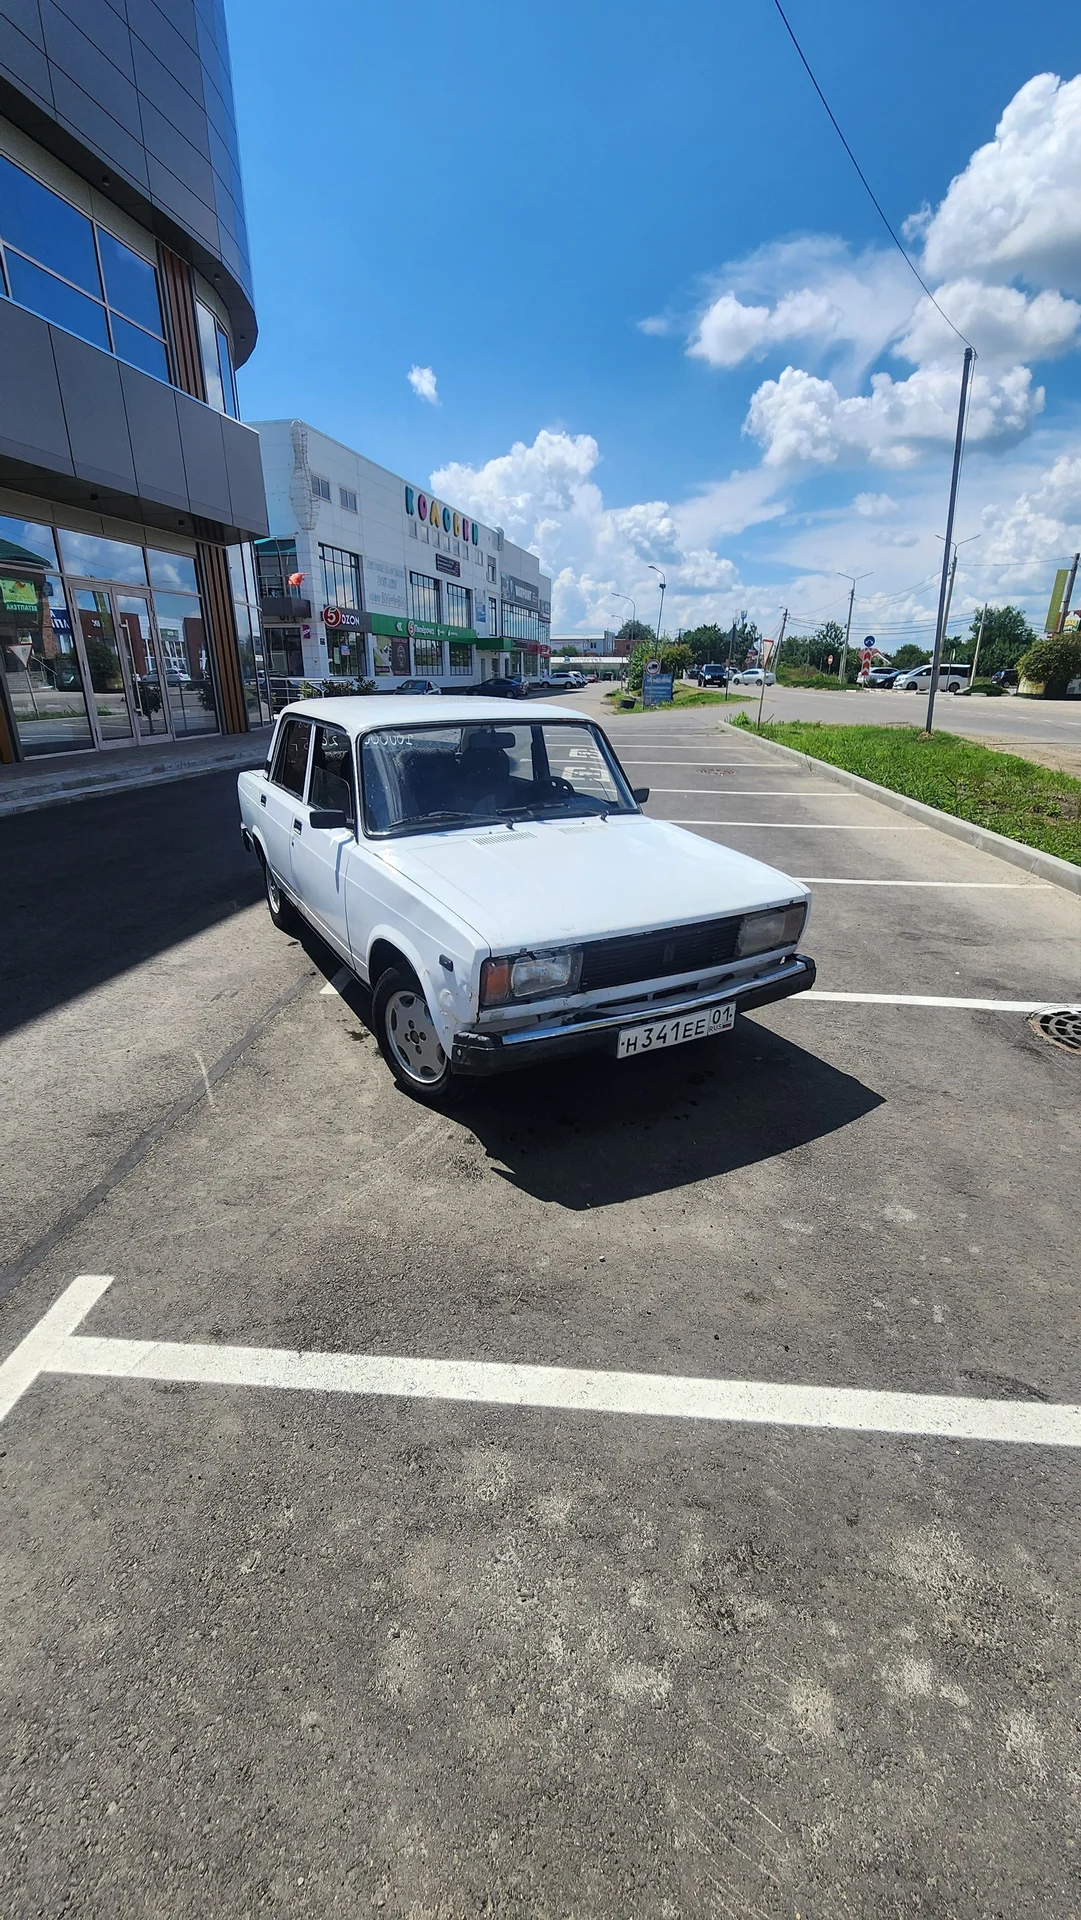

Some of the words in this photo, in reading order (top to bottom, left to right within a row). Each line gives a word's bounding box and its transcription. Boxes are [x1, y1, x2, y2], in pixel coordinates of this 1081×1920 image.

[341, 613, 360, 626] OZON
[712, 1006, 731, 1025] 01
[709, 1024, 722, 1033] RUS
